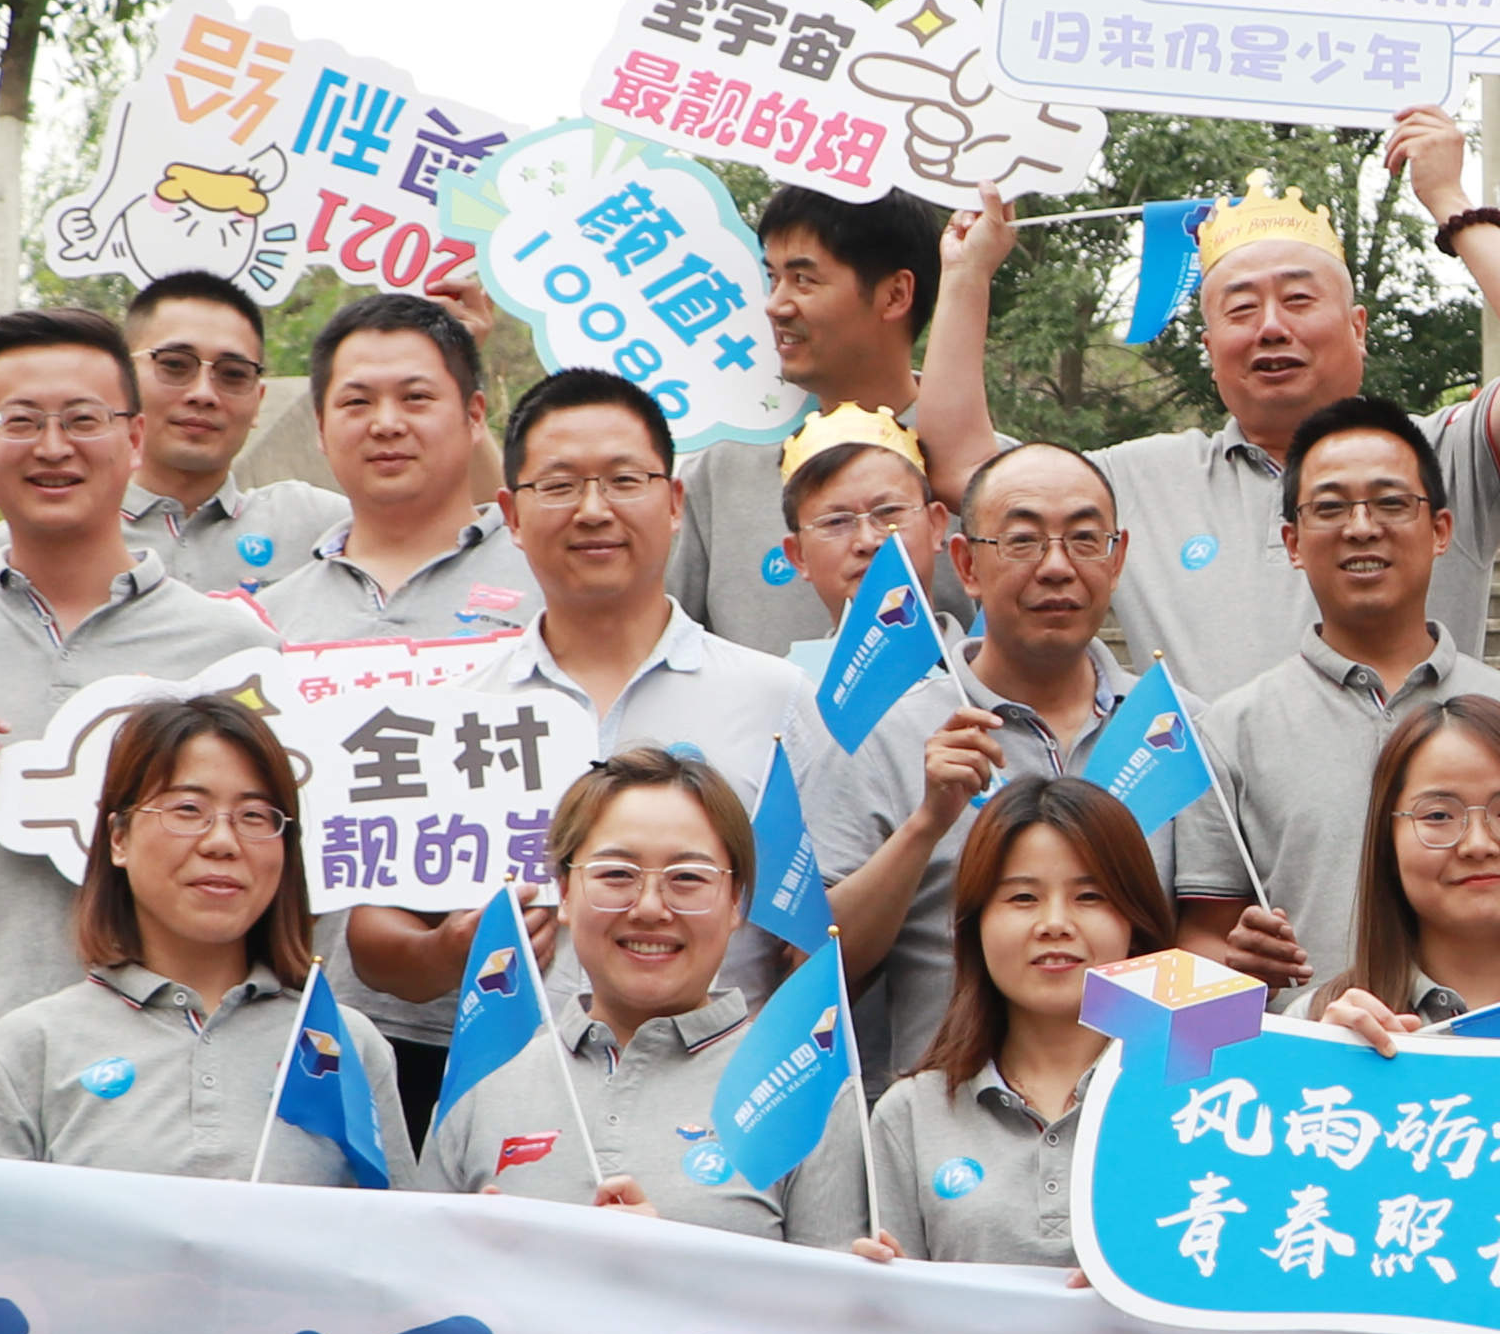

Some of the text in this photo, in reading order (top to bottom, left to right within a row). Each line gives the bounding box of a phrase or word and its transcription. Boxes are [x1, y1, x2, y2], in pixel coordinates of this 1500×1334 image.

[1030, 9, 1422, 91] 归来仍是少年
[600, 49, 888, 188] 最靓的妞
[306, 188, 477, 299] 2021
[575, 180, 758, 372] 颜值+
[513, 230, 690, 420] 10086
[341, 706, 550, 803] 全村
